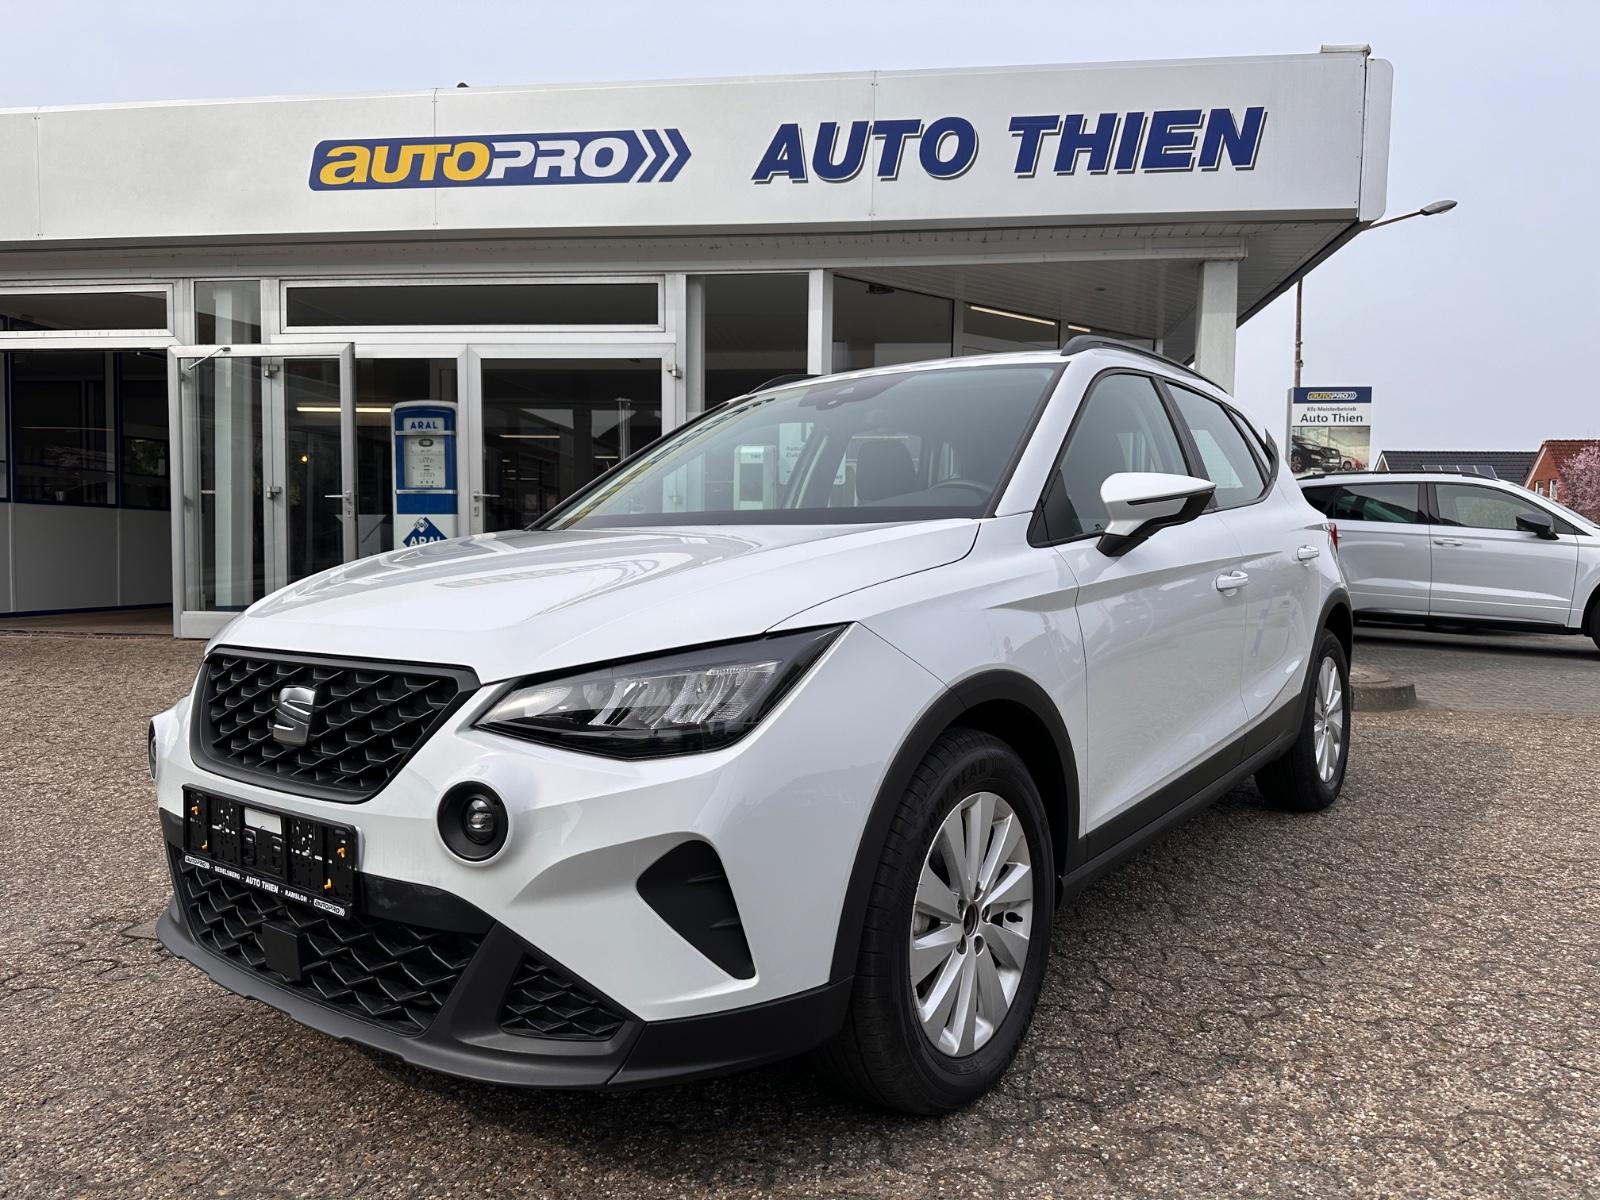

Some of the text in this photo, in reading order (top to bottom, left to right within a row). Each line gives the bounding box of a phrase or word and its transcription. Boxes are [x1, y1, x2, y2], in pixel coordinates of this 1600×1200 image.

[751, 106, 1268, 184] AUTO THIEN
[1300, 413, 1363, 423] Auto Thien
[410, 421, 439, 430] ARAL
[245, 875, 261, 888] AUTO
[261, 880, 279, 894] THIEN
